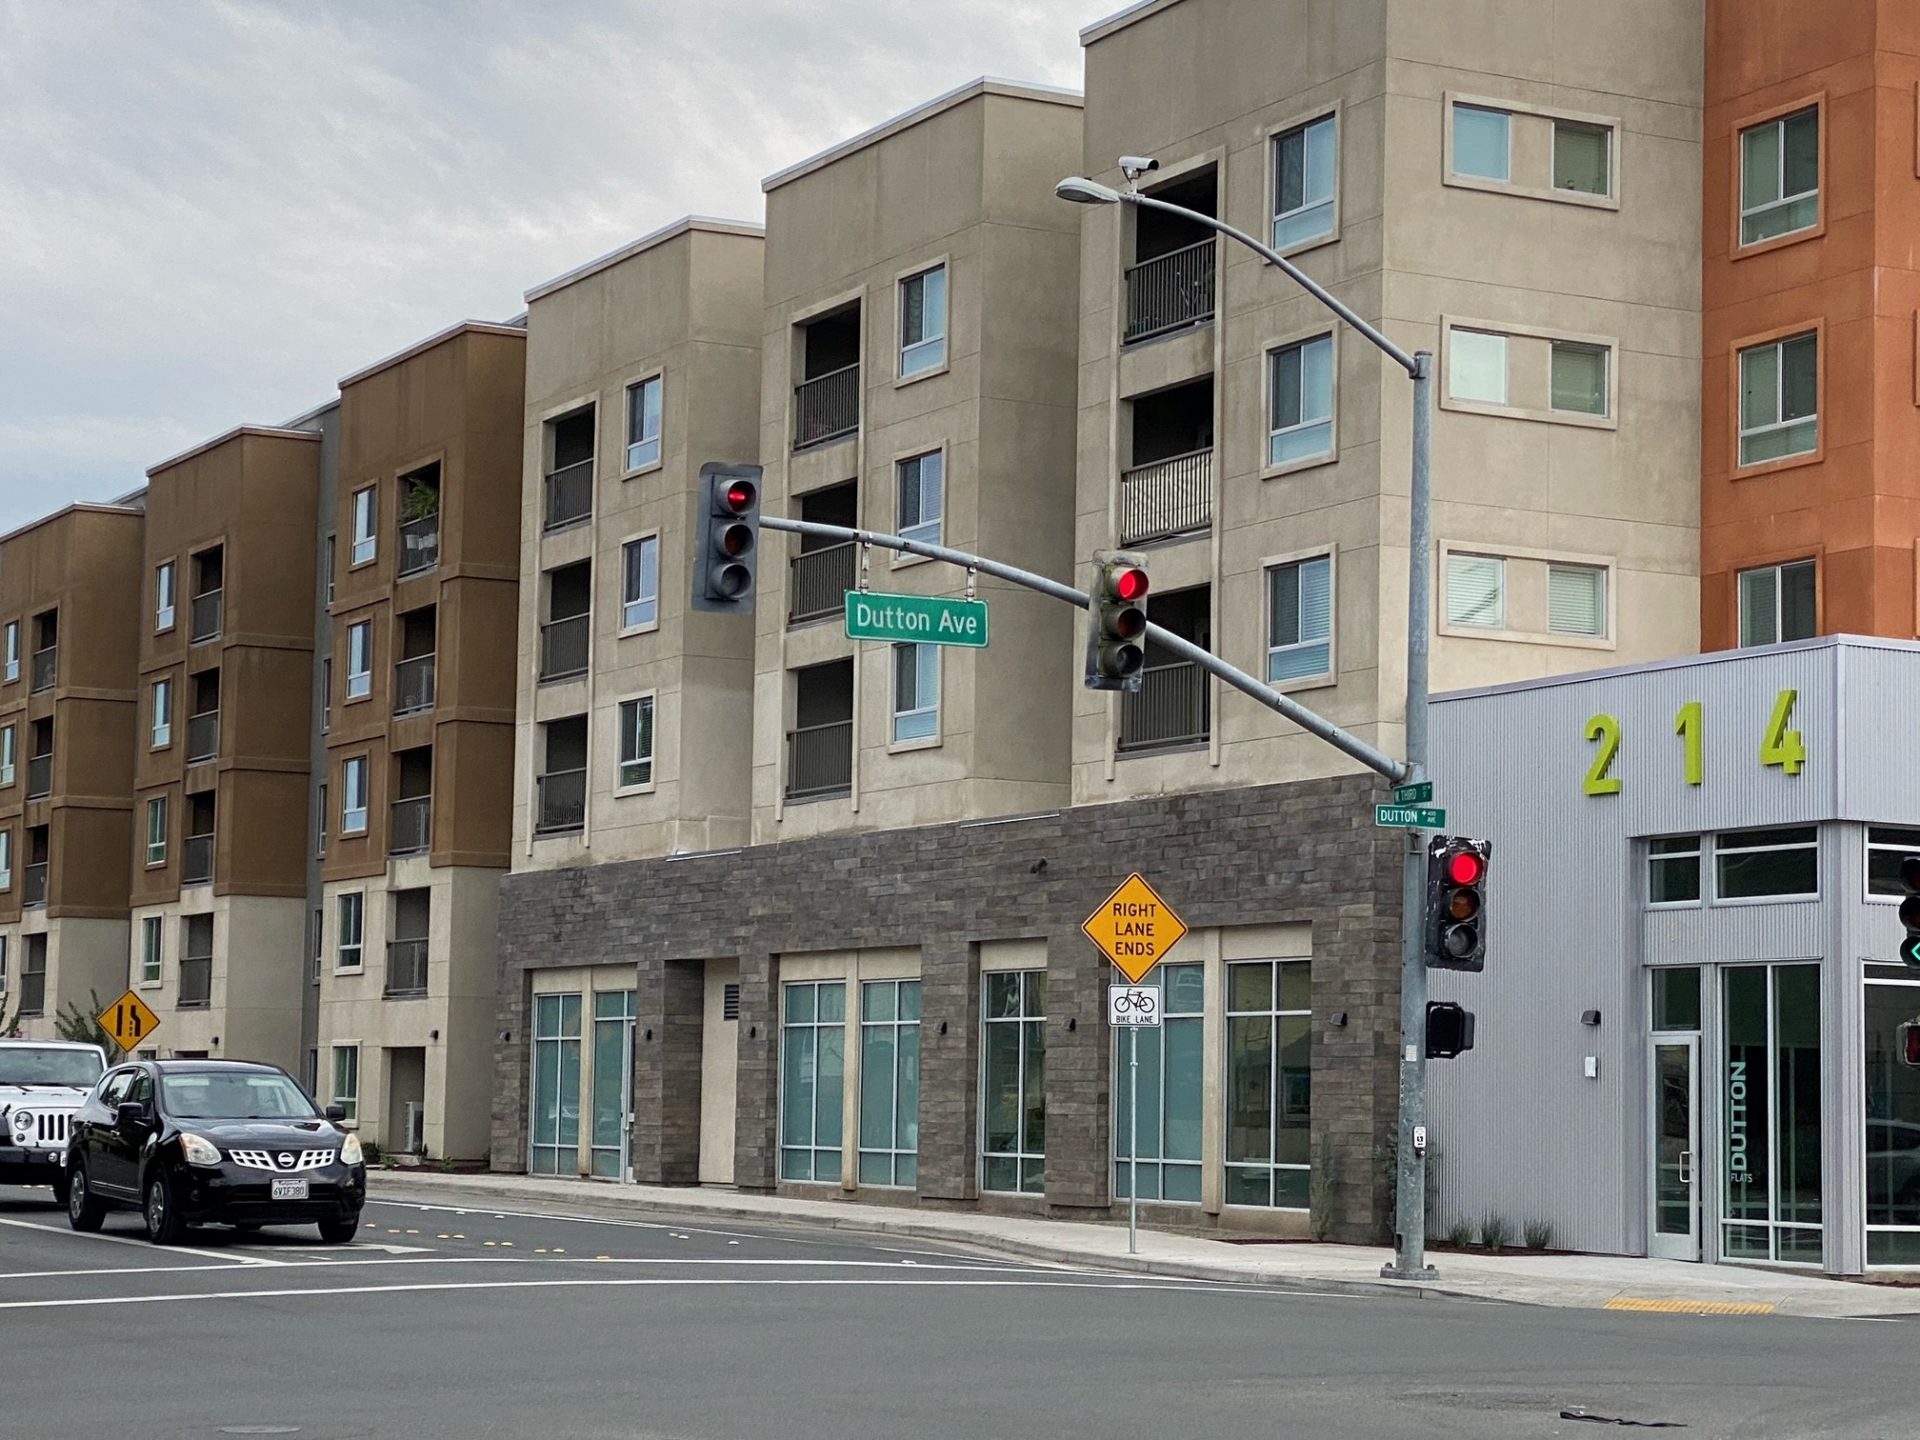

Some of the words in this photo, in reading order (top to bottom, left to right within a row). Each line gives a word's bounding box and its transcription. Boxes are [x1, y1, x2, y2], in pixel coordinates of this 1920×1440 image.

[857, 603, 930, 631] Dutton
[938, 609, 977, 634] Ave
[1583, 689, 1806, 796] 214
[1380, 809, 1418, 823] DUTTON
[1113, 903, 1156, 917] RIGHT
[1115, 922, 1155, 937] LANE
[1115, 941, 1155, 956] ENDS
[1116, 1015, 1131, 1024] BIKE
[1135, 1015, 1153, 1024] LANE
[1730, 1061, 1747, 1171] DUTTON
[1730, 1173, 1753, 1183] FLATS
